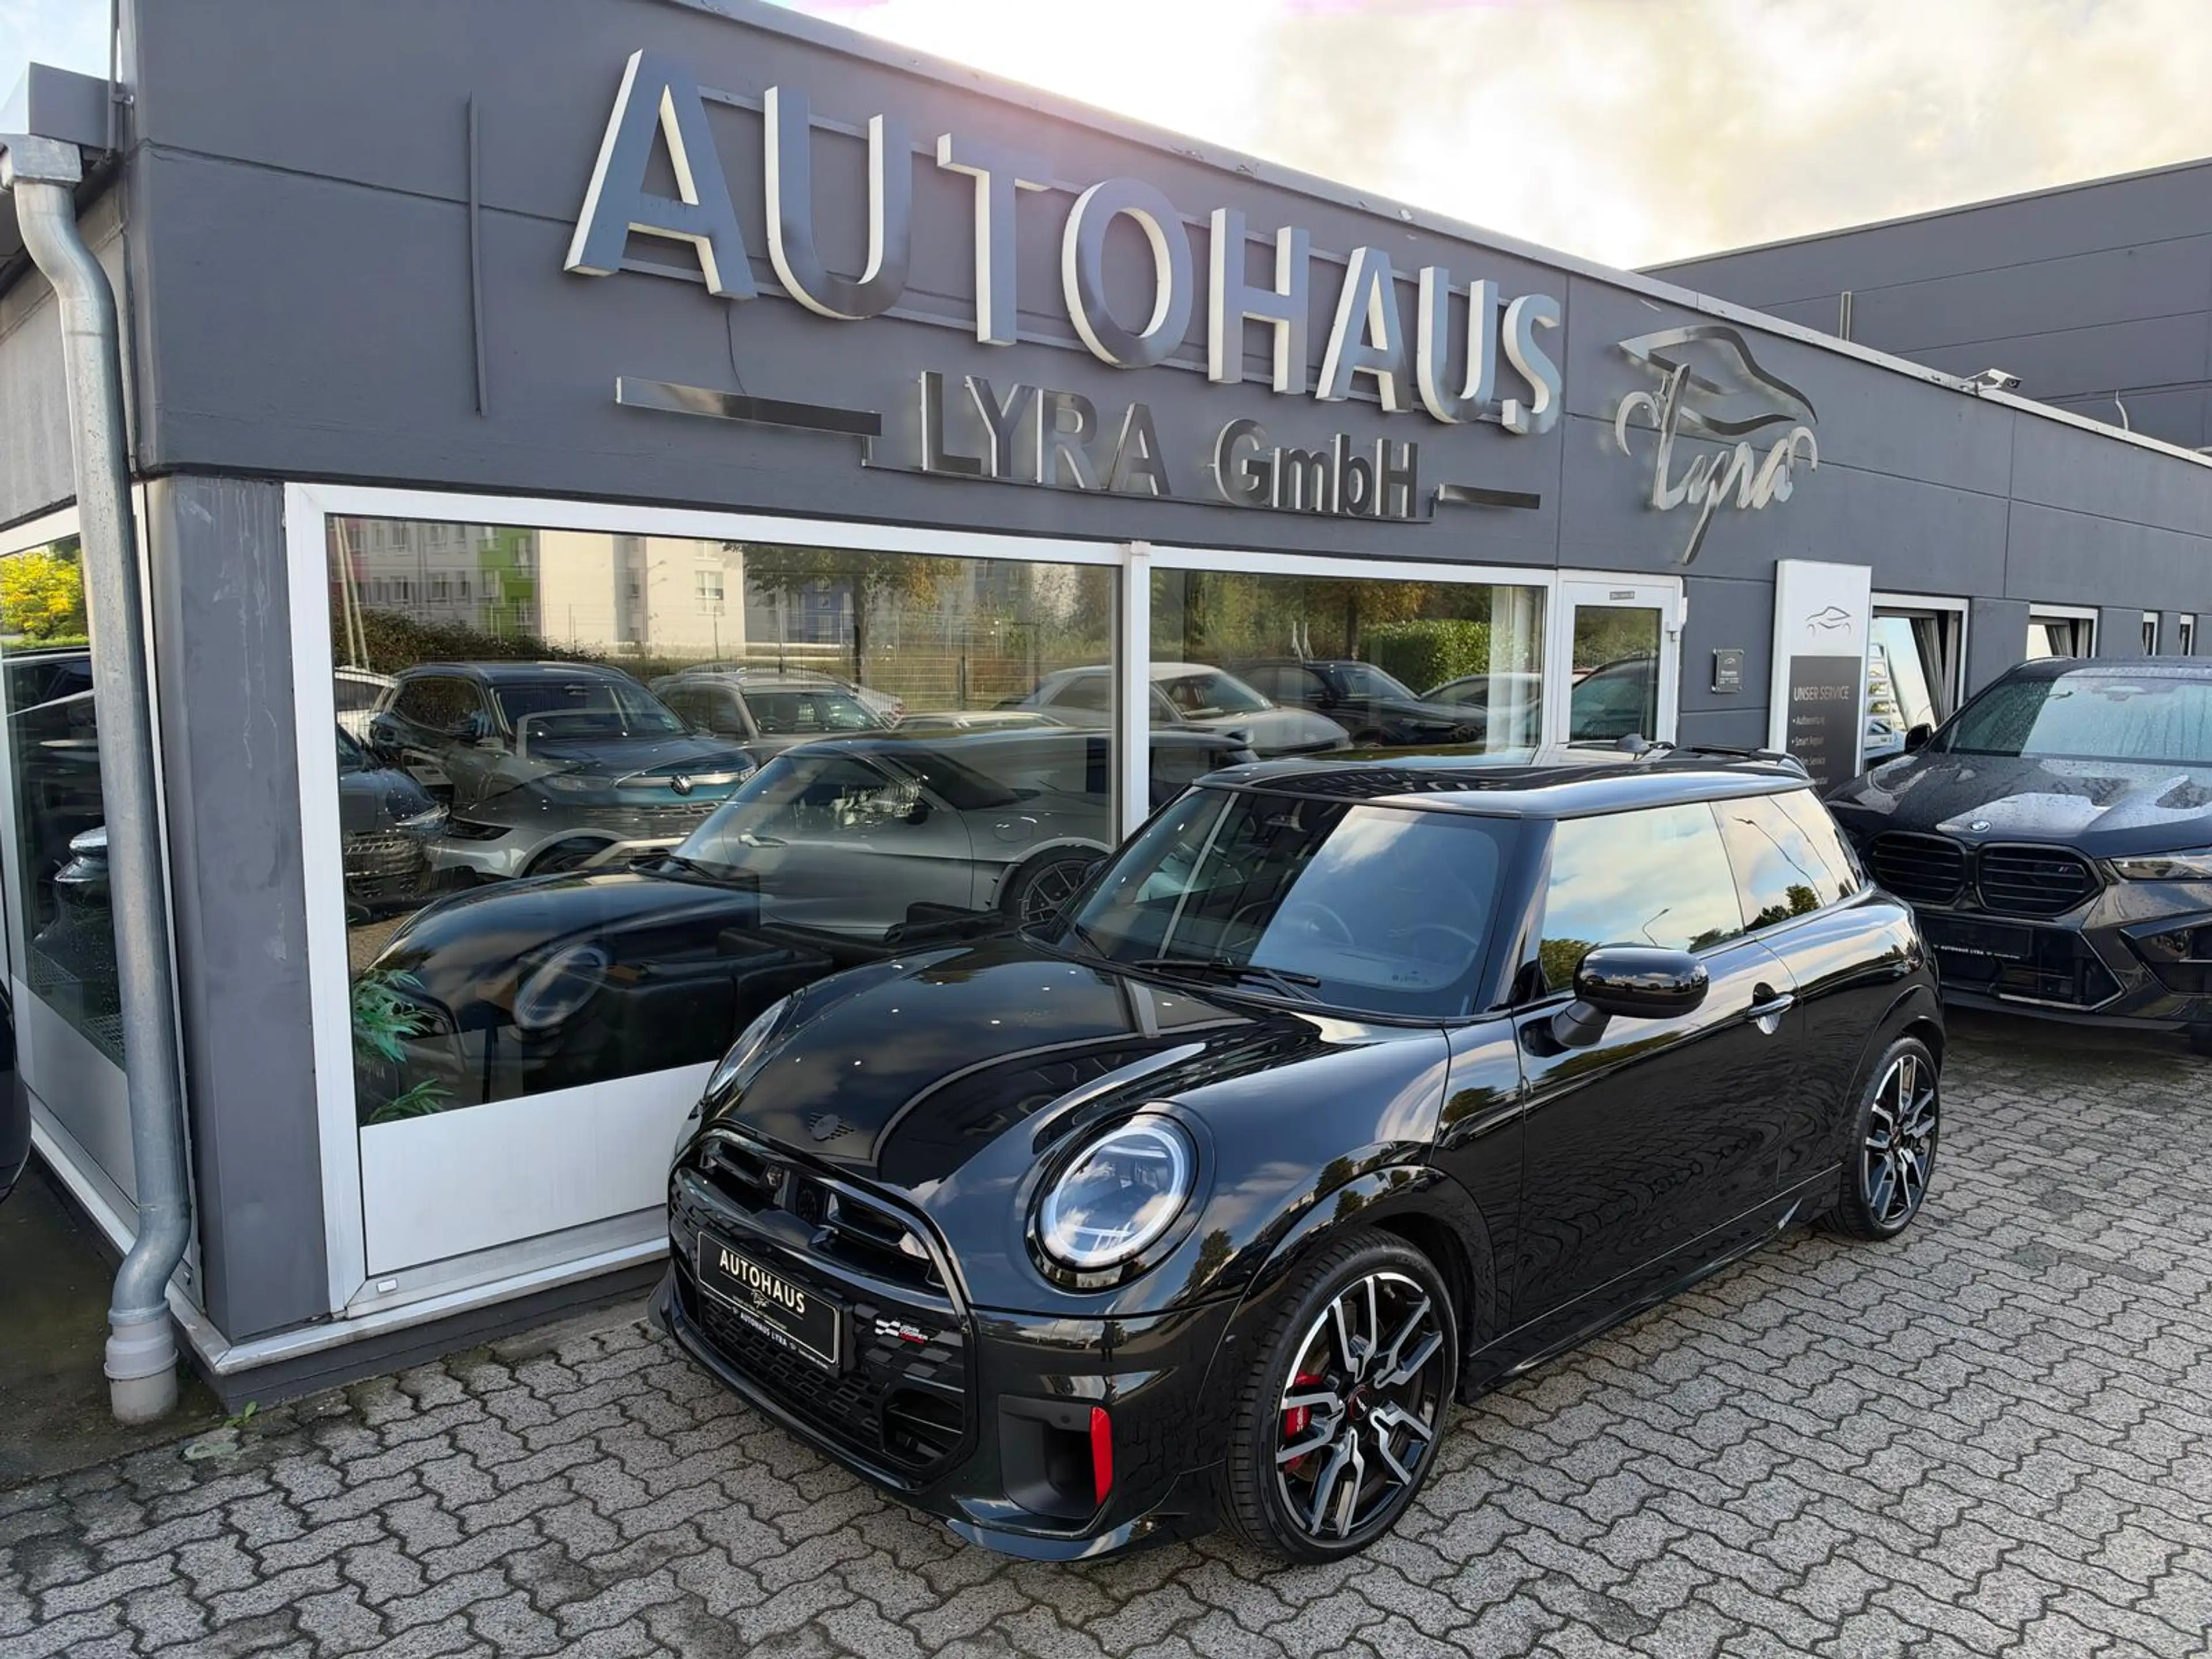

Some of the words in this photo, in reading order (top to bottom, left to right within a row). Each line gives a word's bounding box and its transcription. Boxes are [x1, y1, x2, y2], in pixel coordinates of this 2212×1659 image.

[565, 48, 1562, 435] AUTOHAUS
[921, 370, 1172, 497] LYRA
[1213, 418, 1419, 518] GmbH
[1793, 686, 1818, 701] UNSER
[1819, 685, 1850, 700] SERVICE
[720, 1249, 805, 1313] AUTOHAUS
